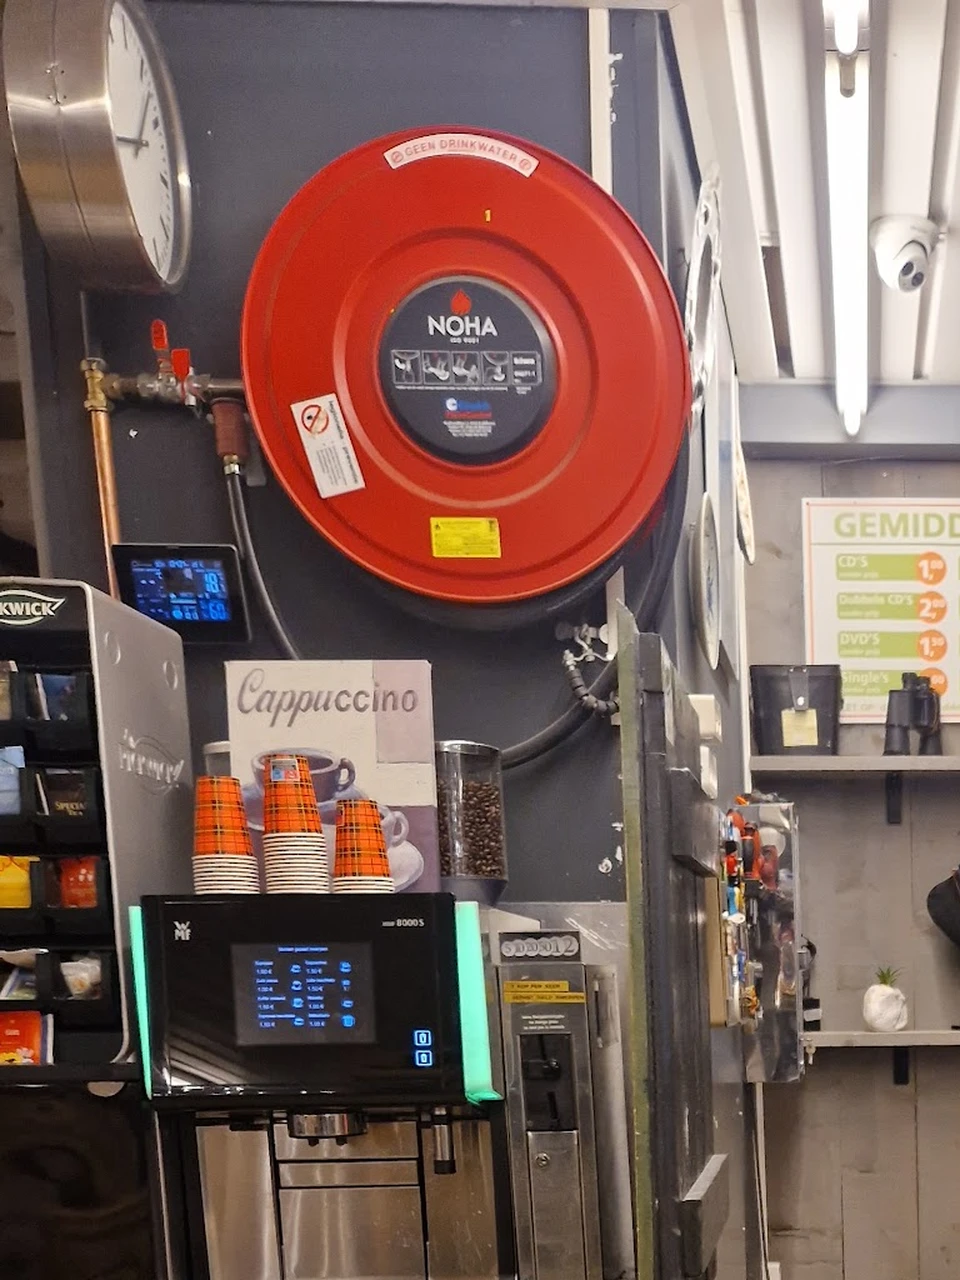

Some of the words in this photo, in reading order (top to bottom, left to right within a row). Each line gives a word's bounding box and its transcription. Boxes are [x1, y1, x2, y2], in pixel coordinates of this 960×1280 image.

[404, 139, 436, 157] GEEN
[439, 139, 518, 162] DRINKWATER
[427, 315, 498, 337] NOHA
[838, 555, 869, 568] CD'S
[887, 594, 914, 605] CD'S
[0, 602, 55, 616] KWICK
[840, 633, 881, 645] DVD'S
[842, 671, 889, 685] Single's
[237, 668, 419, 728] Cappuccino
